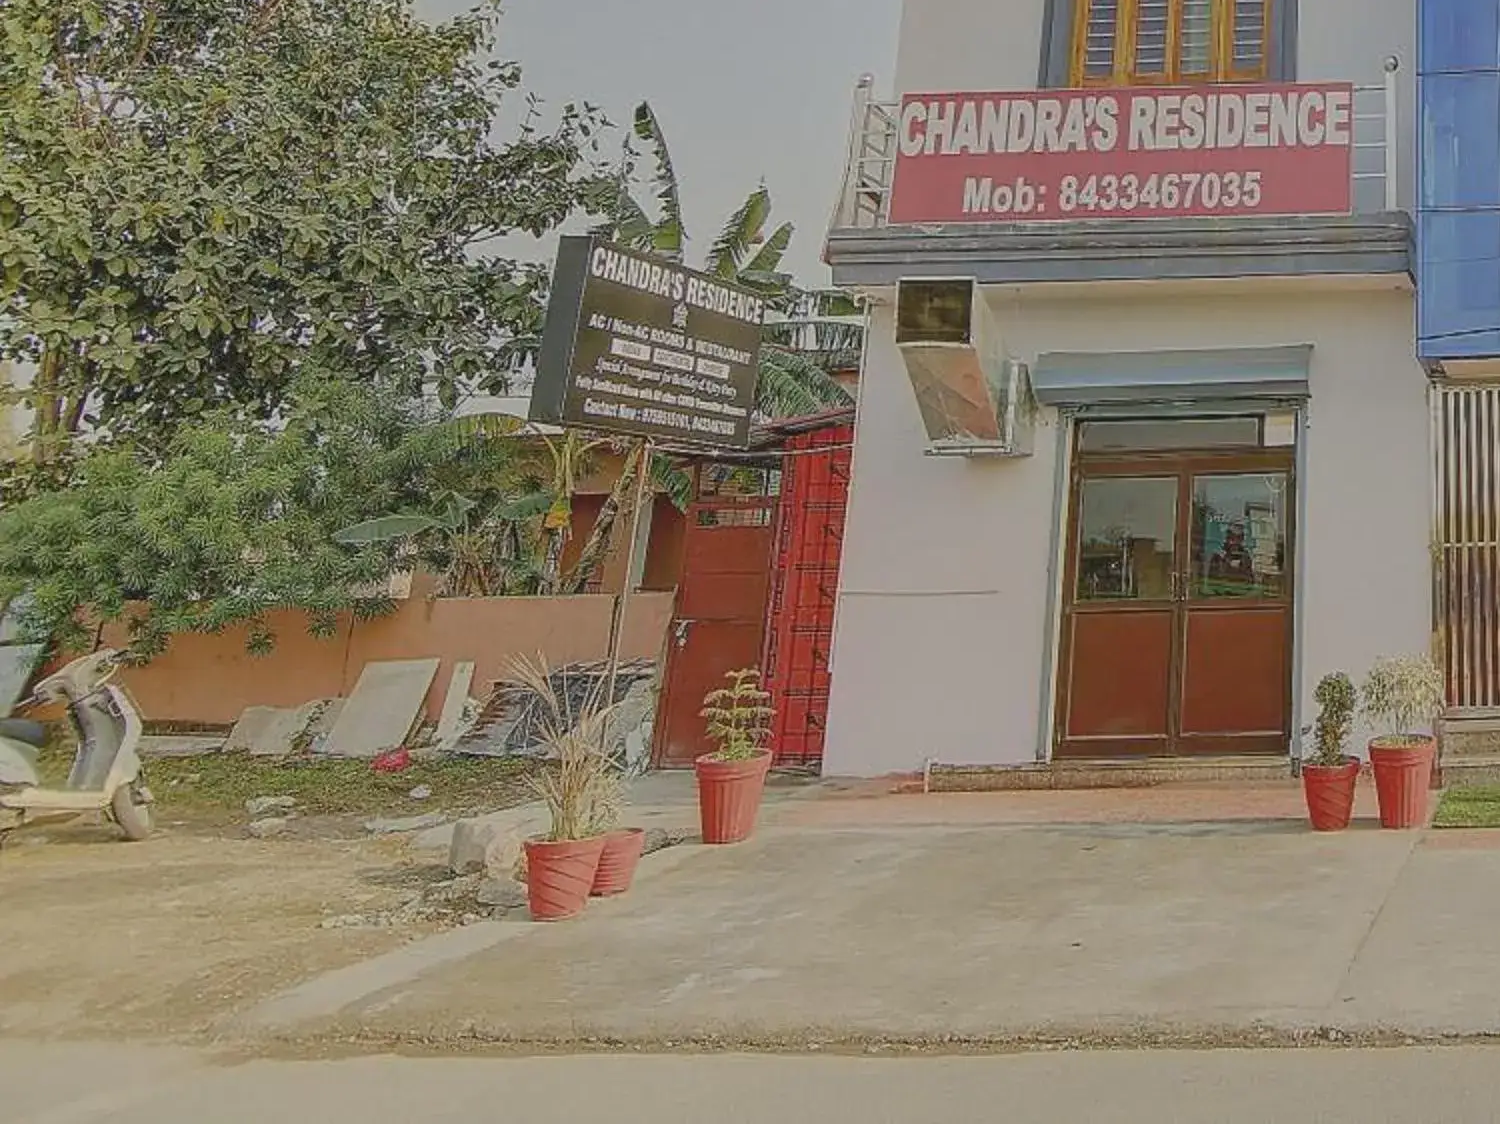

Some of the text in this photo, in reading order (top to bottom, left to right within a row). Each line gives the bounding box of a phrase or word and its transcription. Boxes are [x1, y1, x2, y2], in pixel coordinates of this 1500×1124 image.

[900, 90, 1351, 157] CHANDRA'S RESIDENCE
[962, 171, 1261, 213] Mob: 8433467035
[591, 246, 765, 324] CHANDRA'S RESIDENCE
